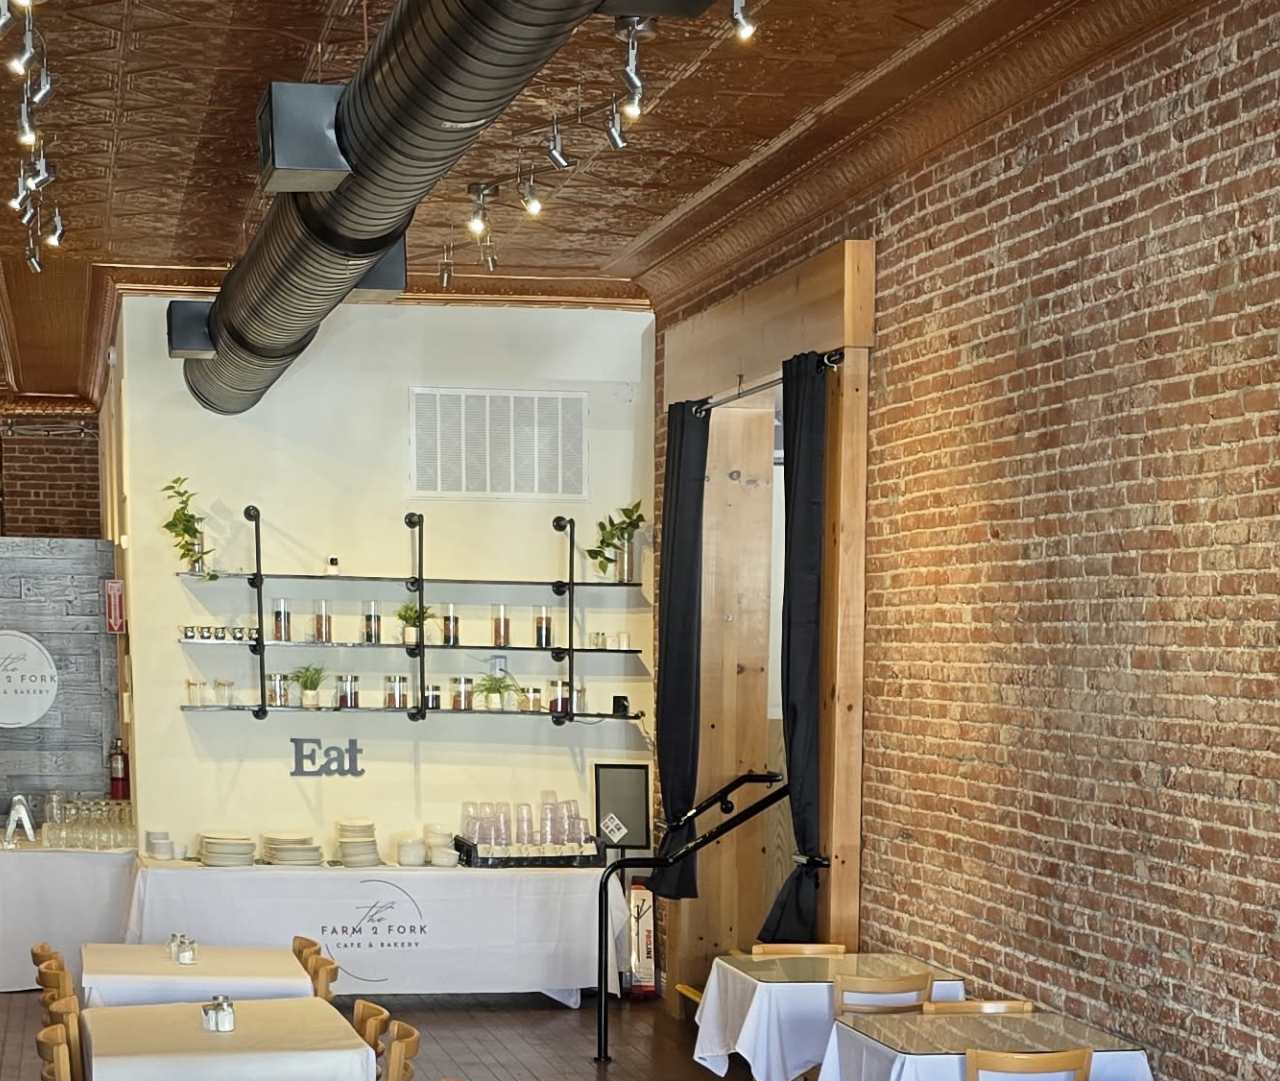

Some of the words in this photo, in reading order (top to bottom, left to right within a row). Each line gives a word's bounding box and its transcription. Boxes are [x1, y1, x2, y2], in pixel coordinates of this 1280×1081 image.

[5, 675, 12, 684] 2
[20, 673, 57, 683] FORK
[290, 737, 366, 776] Eat
[321, 925, 362, 935] FARM
[371, 926, 378, 935] 2
[387, 924, 428, 935] FORK
